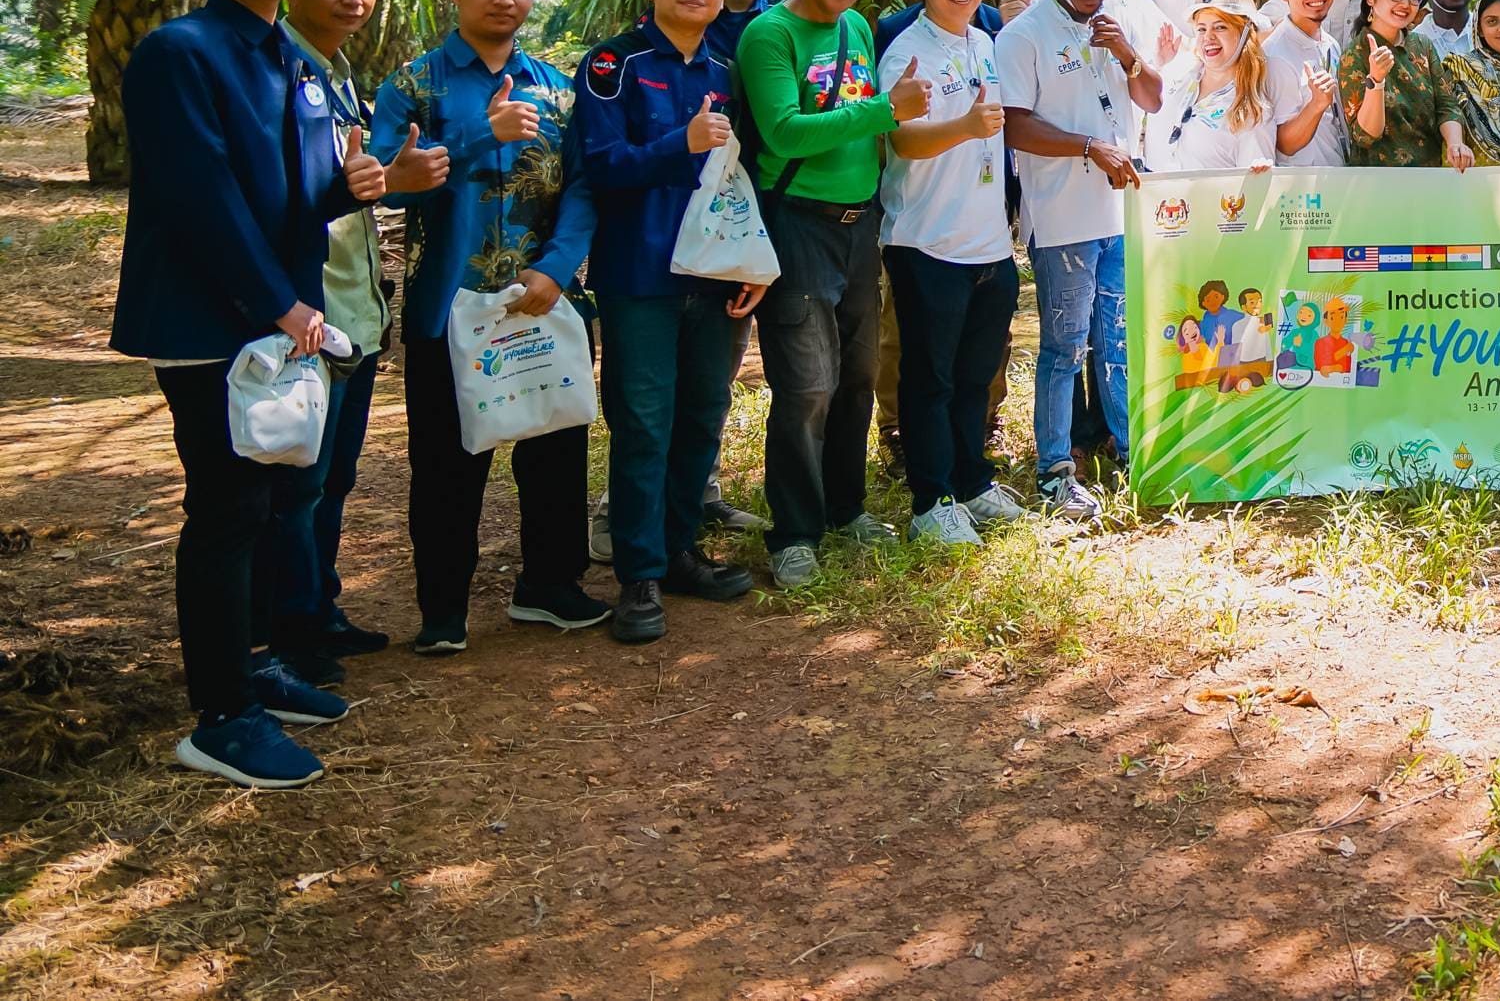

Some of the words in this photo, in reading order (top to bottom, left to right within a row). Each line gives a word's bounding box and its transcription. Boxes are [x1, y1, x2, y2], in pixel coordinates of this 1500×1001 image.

[1058, 59, 1081, 73] CPOPC
[1280, 211, 1330, 219] Agricultura
[1468, 402, 1478, 412] 13
[1487, 402, 1498, 412] 17
